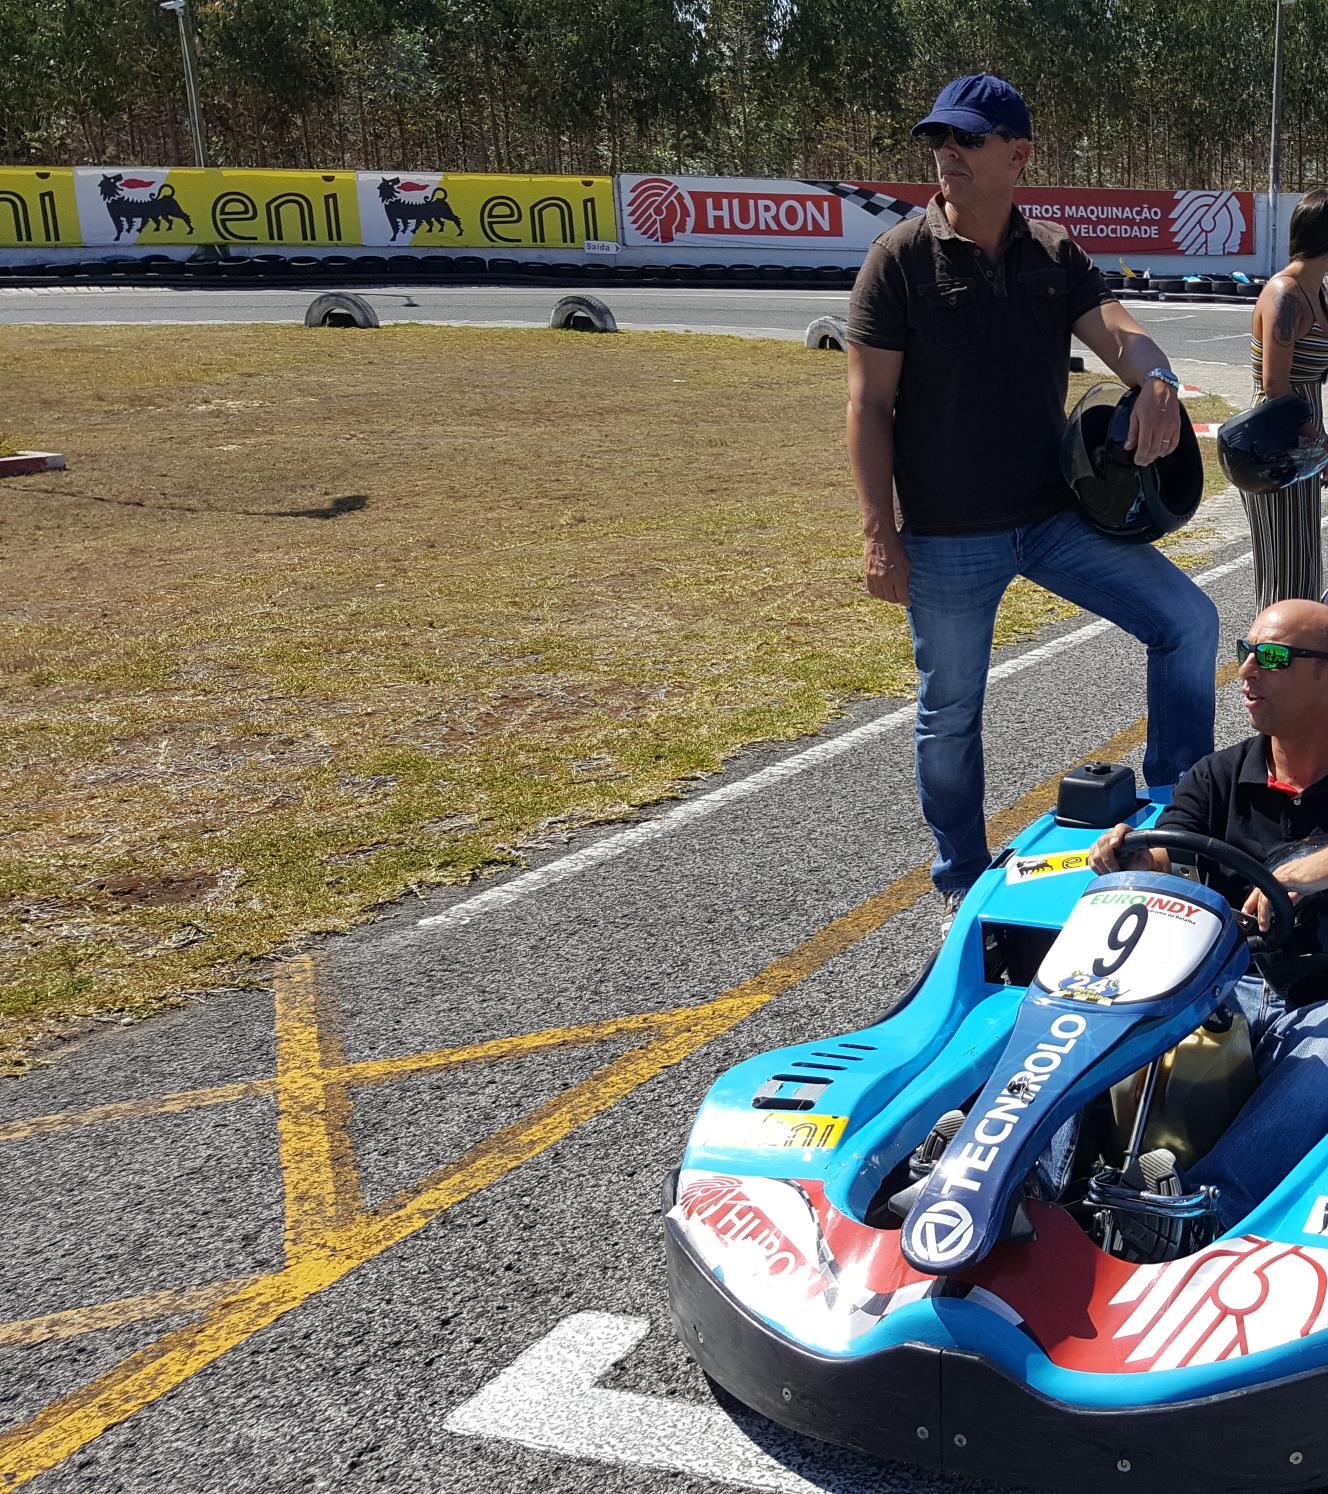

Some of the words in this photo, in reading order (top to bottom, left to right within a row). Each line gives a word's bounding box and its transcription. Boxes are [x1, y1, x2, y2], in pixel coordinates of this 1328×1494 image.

[0, 172, 60, 242] ni
[211, 174, 342, 242] eni
[480, 179, 599, 243] eni
[706, 197, 830, 233] HURON
[1064, 204, 1161, 222] MAQUINAÇÃO
[1070, 224, 1159, 238] VELOCIDADE
[1090, 894, 1201, 918] EUROINDY
[1092, 903, 1148, 977] 9
[1066, 975, 1110, 993] 24
[940, 1013, 1087, 1197] TECNIROLO
